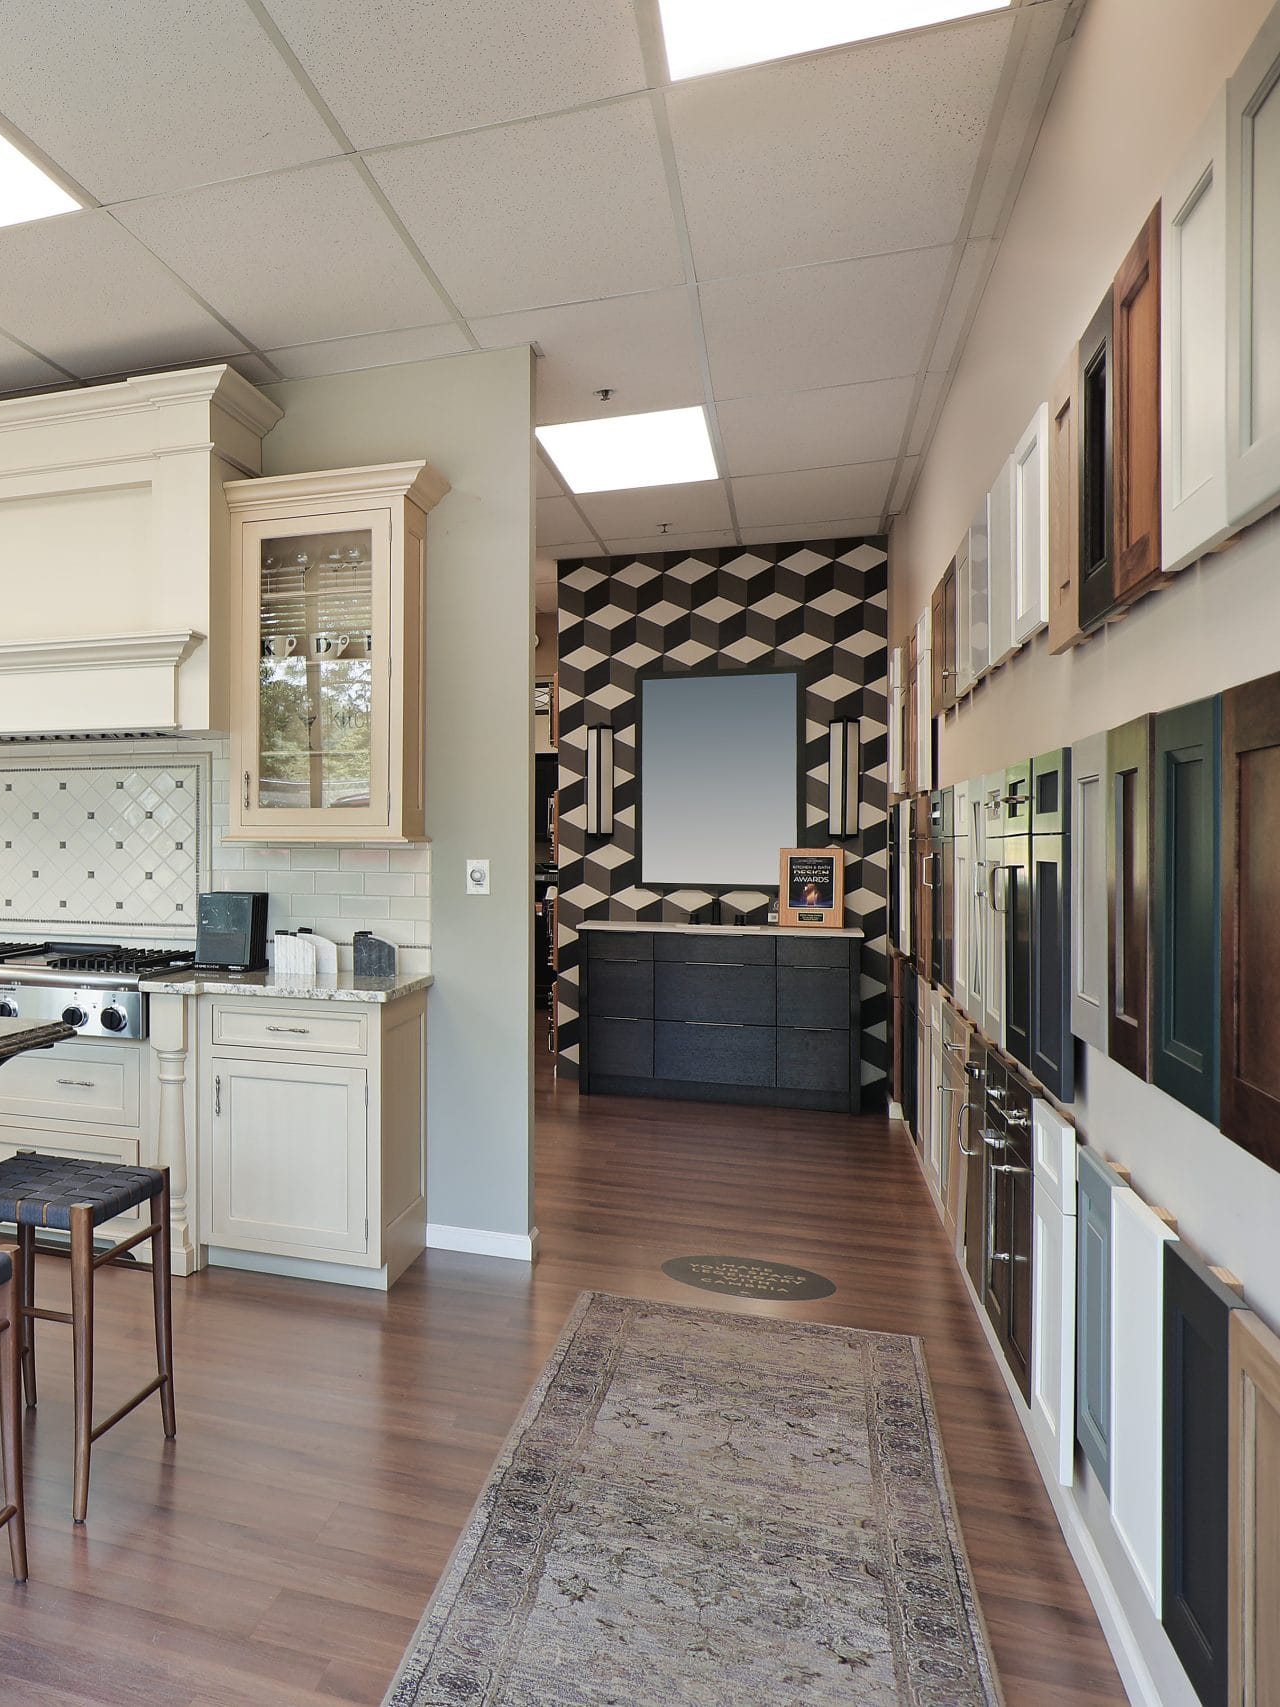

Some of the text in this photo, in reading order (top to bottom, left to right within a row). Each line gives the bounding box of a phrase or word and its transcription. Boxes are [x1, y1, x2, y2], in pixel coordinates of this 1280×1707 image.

[316, 637, 332, 653] D
[689, 1263, 807, 1281] YOUR SPACE
[722, 1263, 773, 1273] MAKE
[701, 1278, 789, 1293] CAMBRIA
[723, 1276, 770, 1286] WITH
